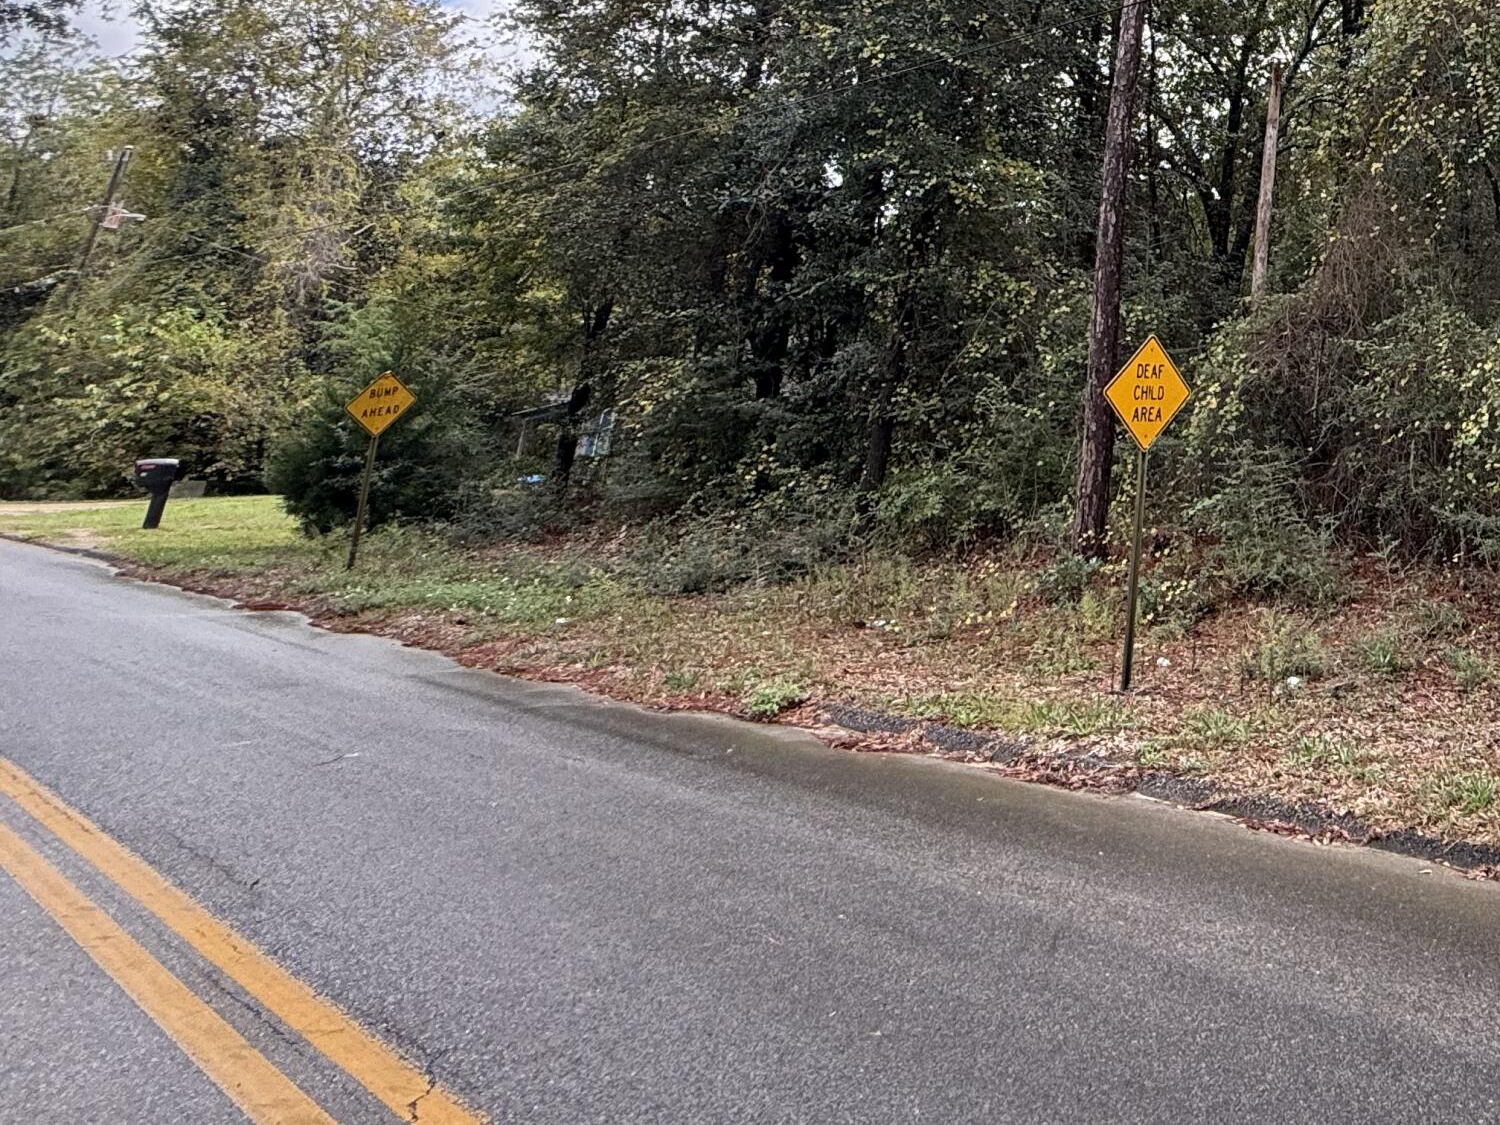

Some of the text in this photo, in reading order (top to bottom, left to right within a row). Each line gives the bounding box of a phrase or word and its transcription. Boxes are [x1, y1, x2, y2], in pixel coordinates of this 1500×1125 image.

[1136, 363, 1165, 379] DEAF
[369, 386, 399, 399] BUMP
[1133, 385, 1165, 400] CHILD
[361, 404, 400, 418] AHEAD
[1131, 406, 1162, 422] AREA
